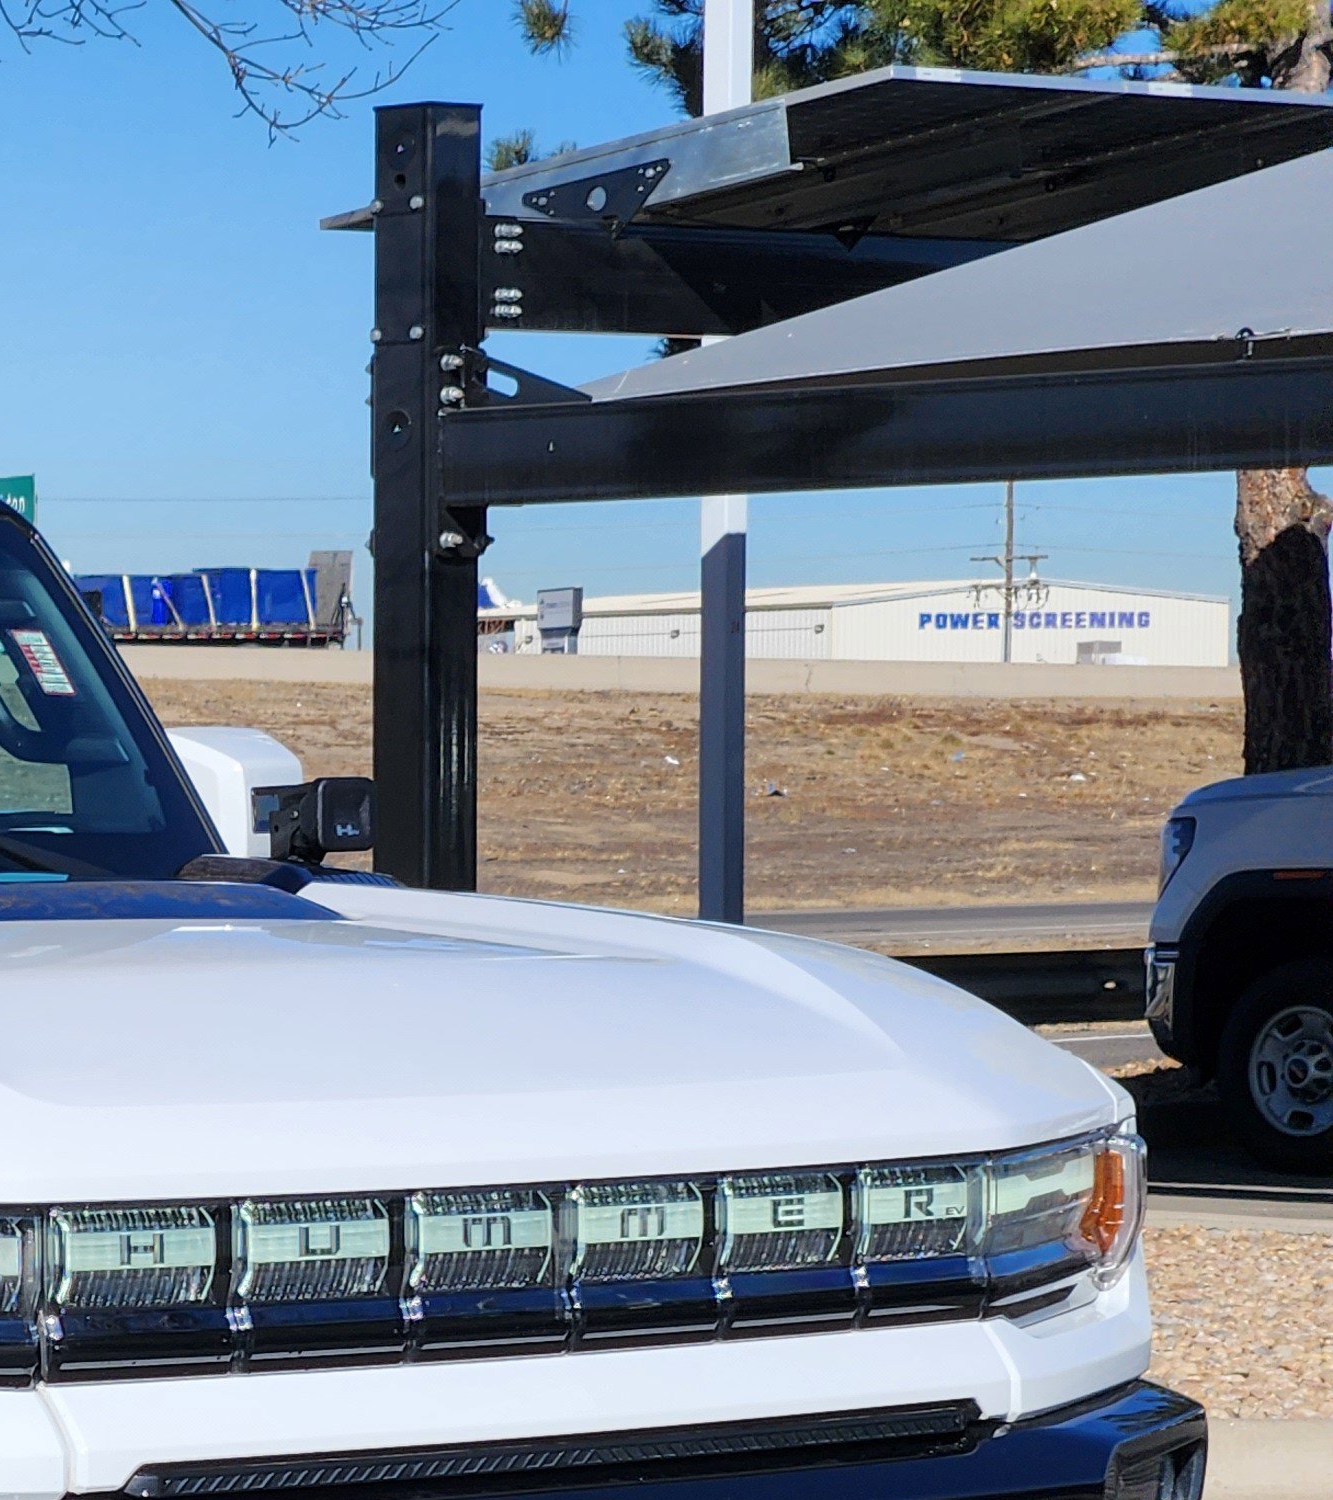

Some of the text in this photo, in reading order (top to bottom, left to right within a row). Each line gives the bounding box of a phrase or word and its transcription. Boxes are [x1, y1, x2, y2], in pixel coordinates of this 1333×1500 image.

[918, 611, 1151, 630] POWER SCREENING
[119, 1187, 966, 1266] HUMMER EV
